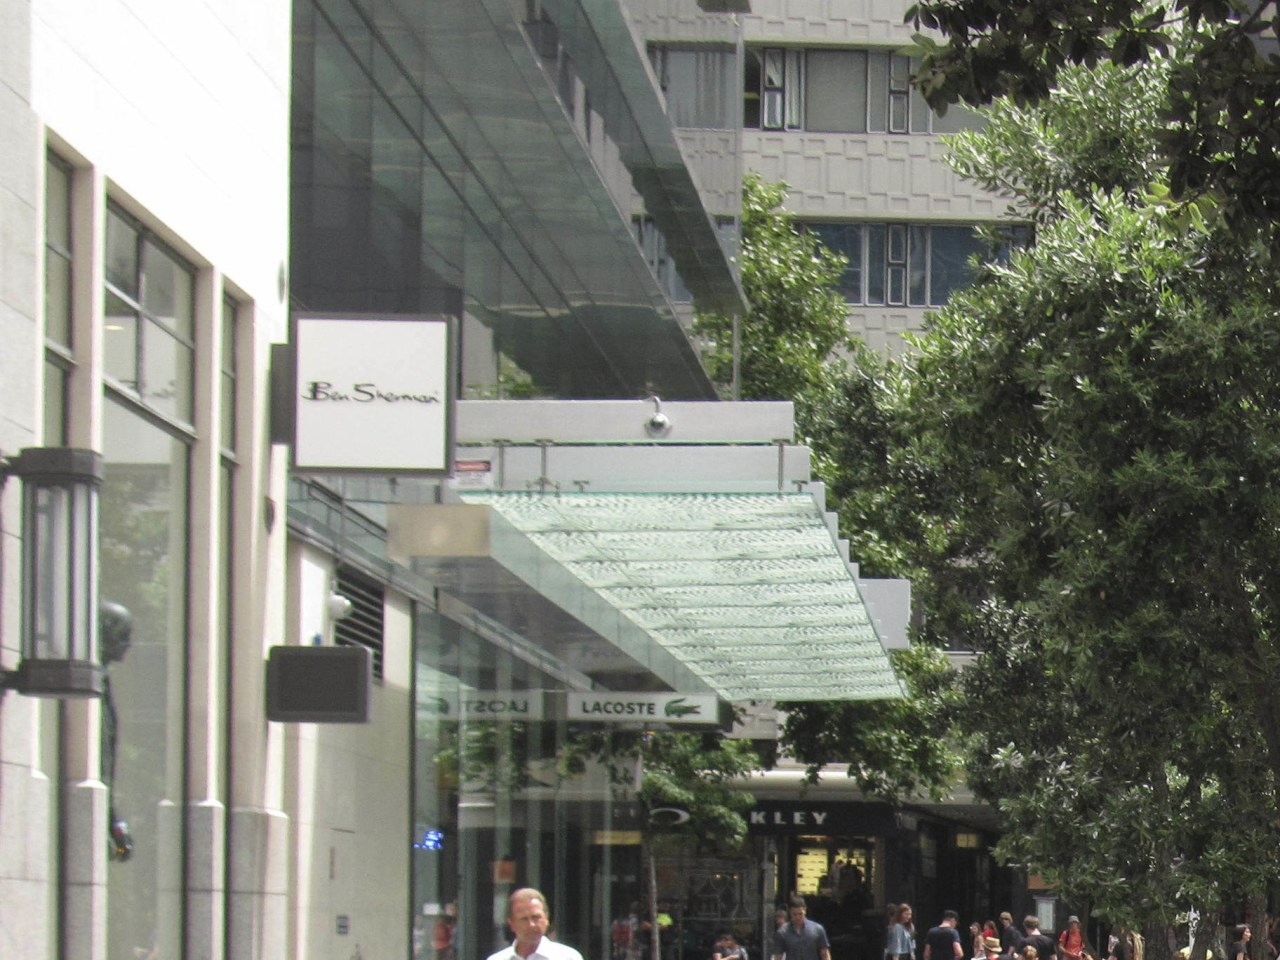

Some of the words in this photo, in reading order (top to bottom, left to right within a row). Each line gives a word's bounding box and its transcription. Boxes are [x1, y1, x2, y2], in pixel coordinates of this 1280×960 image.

[302, 381, 349, 401] Ben
[352, 383, 438, 403] Sherman
[582, 702, 655, 715] LACOSTE
[751, 811, 827, 825] KLEY
